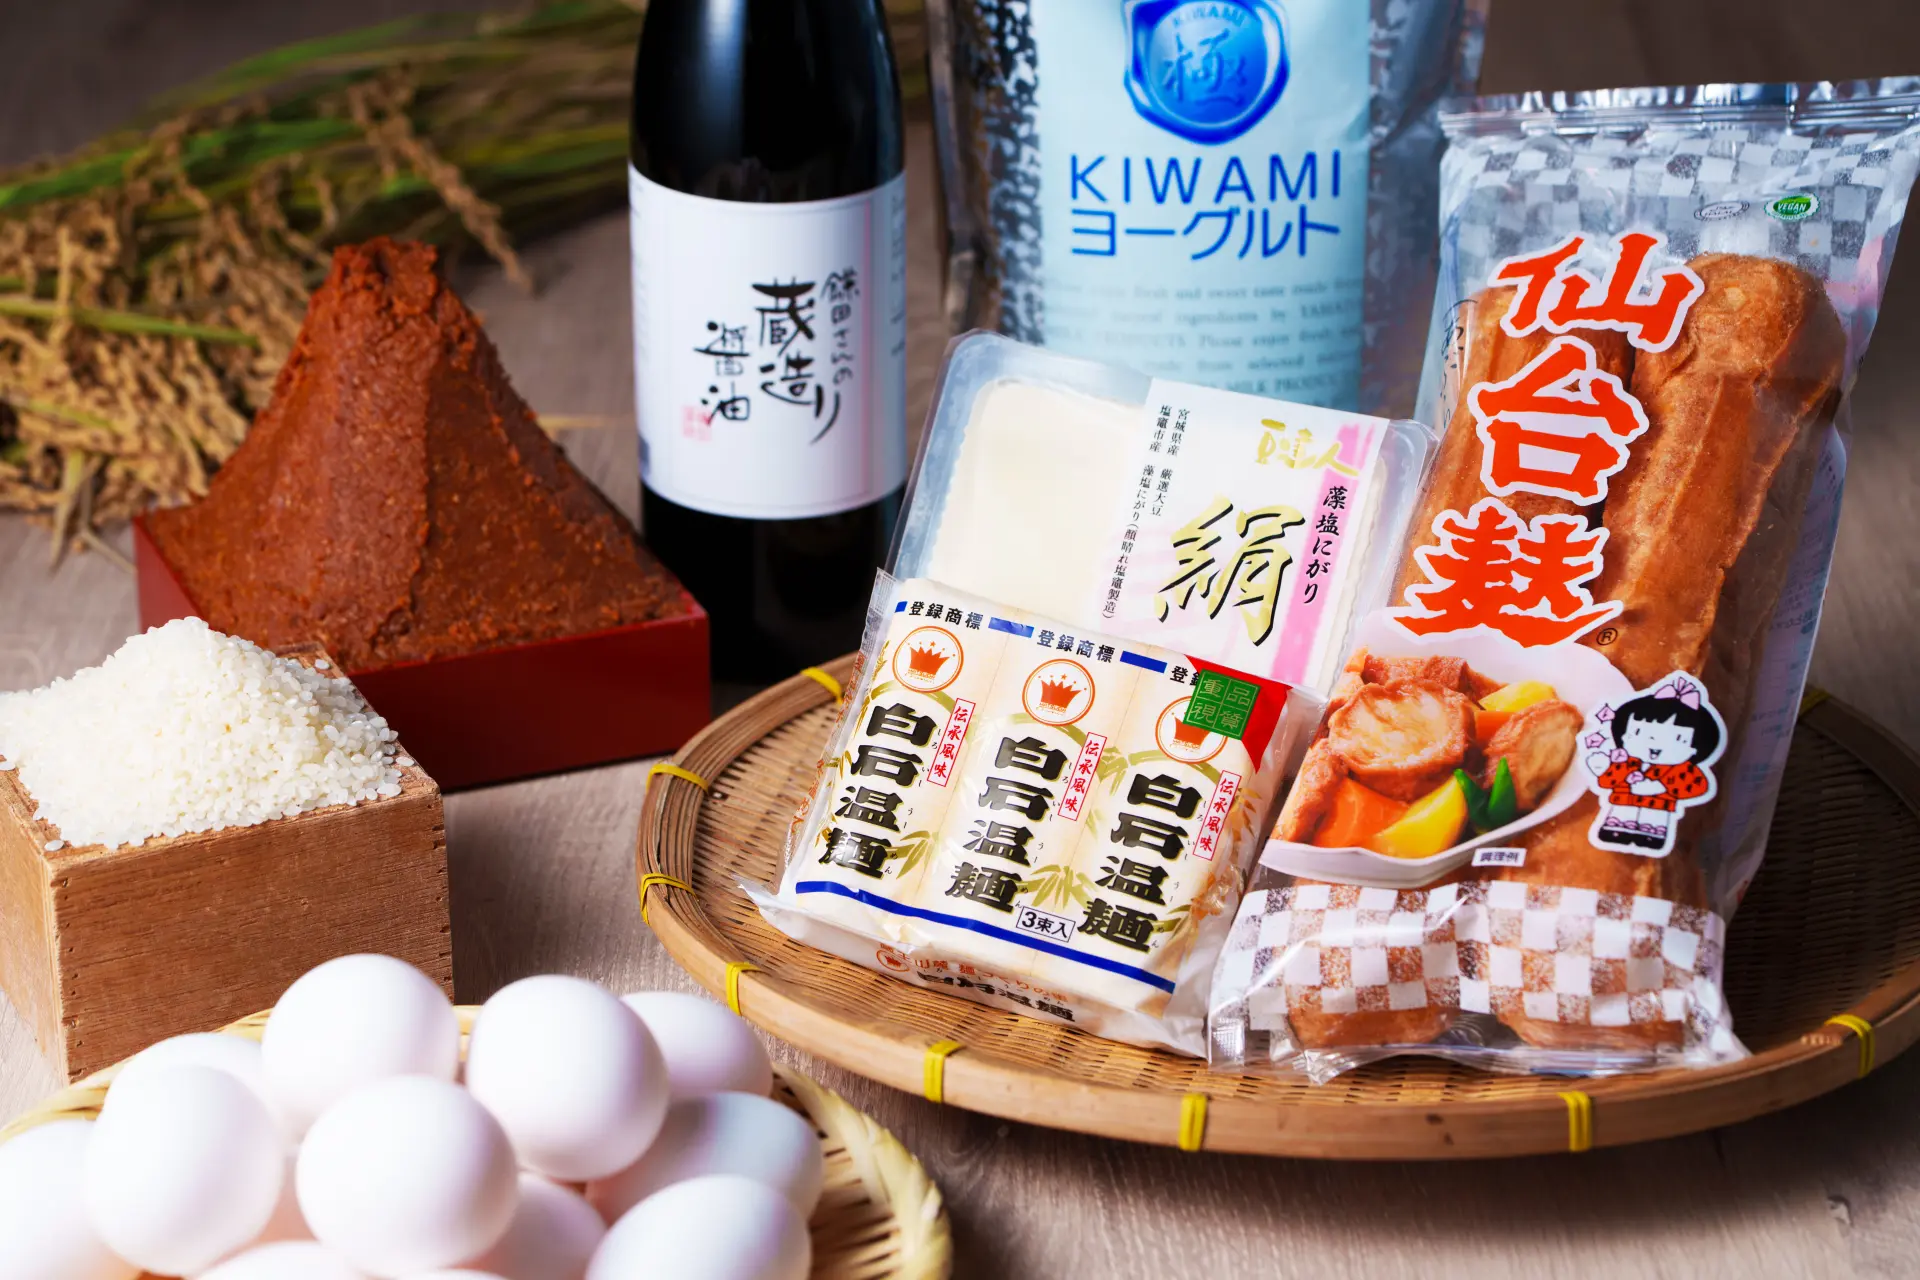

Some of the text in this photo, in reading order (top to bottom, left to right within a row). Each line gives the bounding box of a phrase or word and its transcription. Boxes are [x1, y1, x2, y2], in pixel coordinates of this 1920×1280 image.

[1070, 150, 1341, 204] KIWAMI
[1777, 202, 1807, 213] VEGAN
[1070, 204, 1341, 261] ヨーグルト
[751, 276, 840, 446] 蔵造り
[1150, 408, 1190, 517] 宮城県産 厳選大豆
[1391, 233, 1696, 648] 仙台麩
[1154, 493, 1306, 647] 絹
[1303, 486, 1348, 604] 藻塩にがり
[908, 601, 984, 630] 登録商標
[1037, 630, 1116, 663] 登録商標
[1190, 679, 1225, 723] 重視
[1220, 687, 1251, 729] 品質
[932, 706, 968, 779] 伝承風味
[1065, 740, 1099, 813] 伝承風味
[818, 703, 937, 880] 白石温麺
[945, 736, 1068, 913] 白石温麺
[1201, 778, 1235, 852] 伝承風味
[1077, 773, 1202, 954] 白石温麺
[1021, 911, 1069, 939] 3束入
